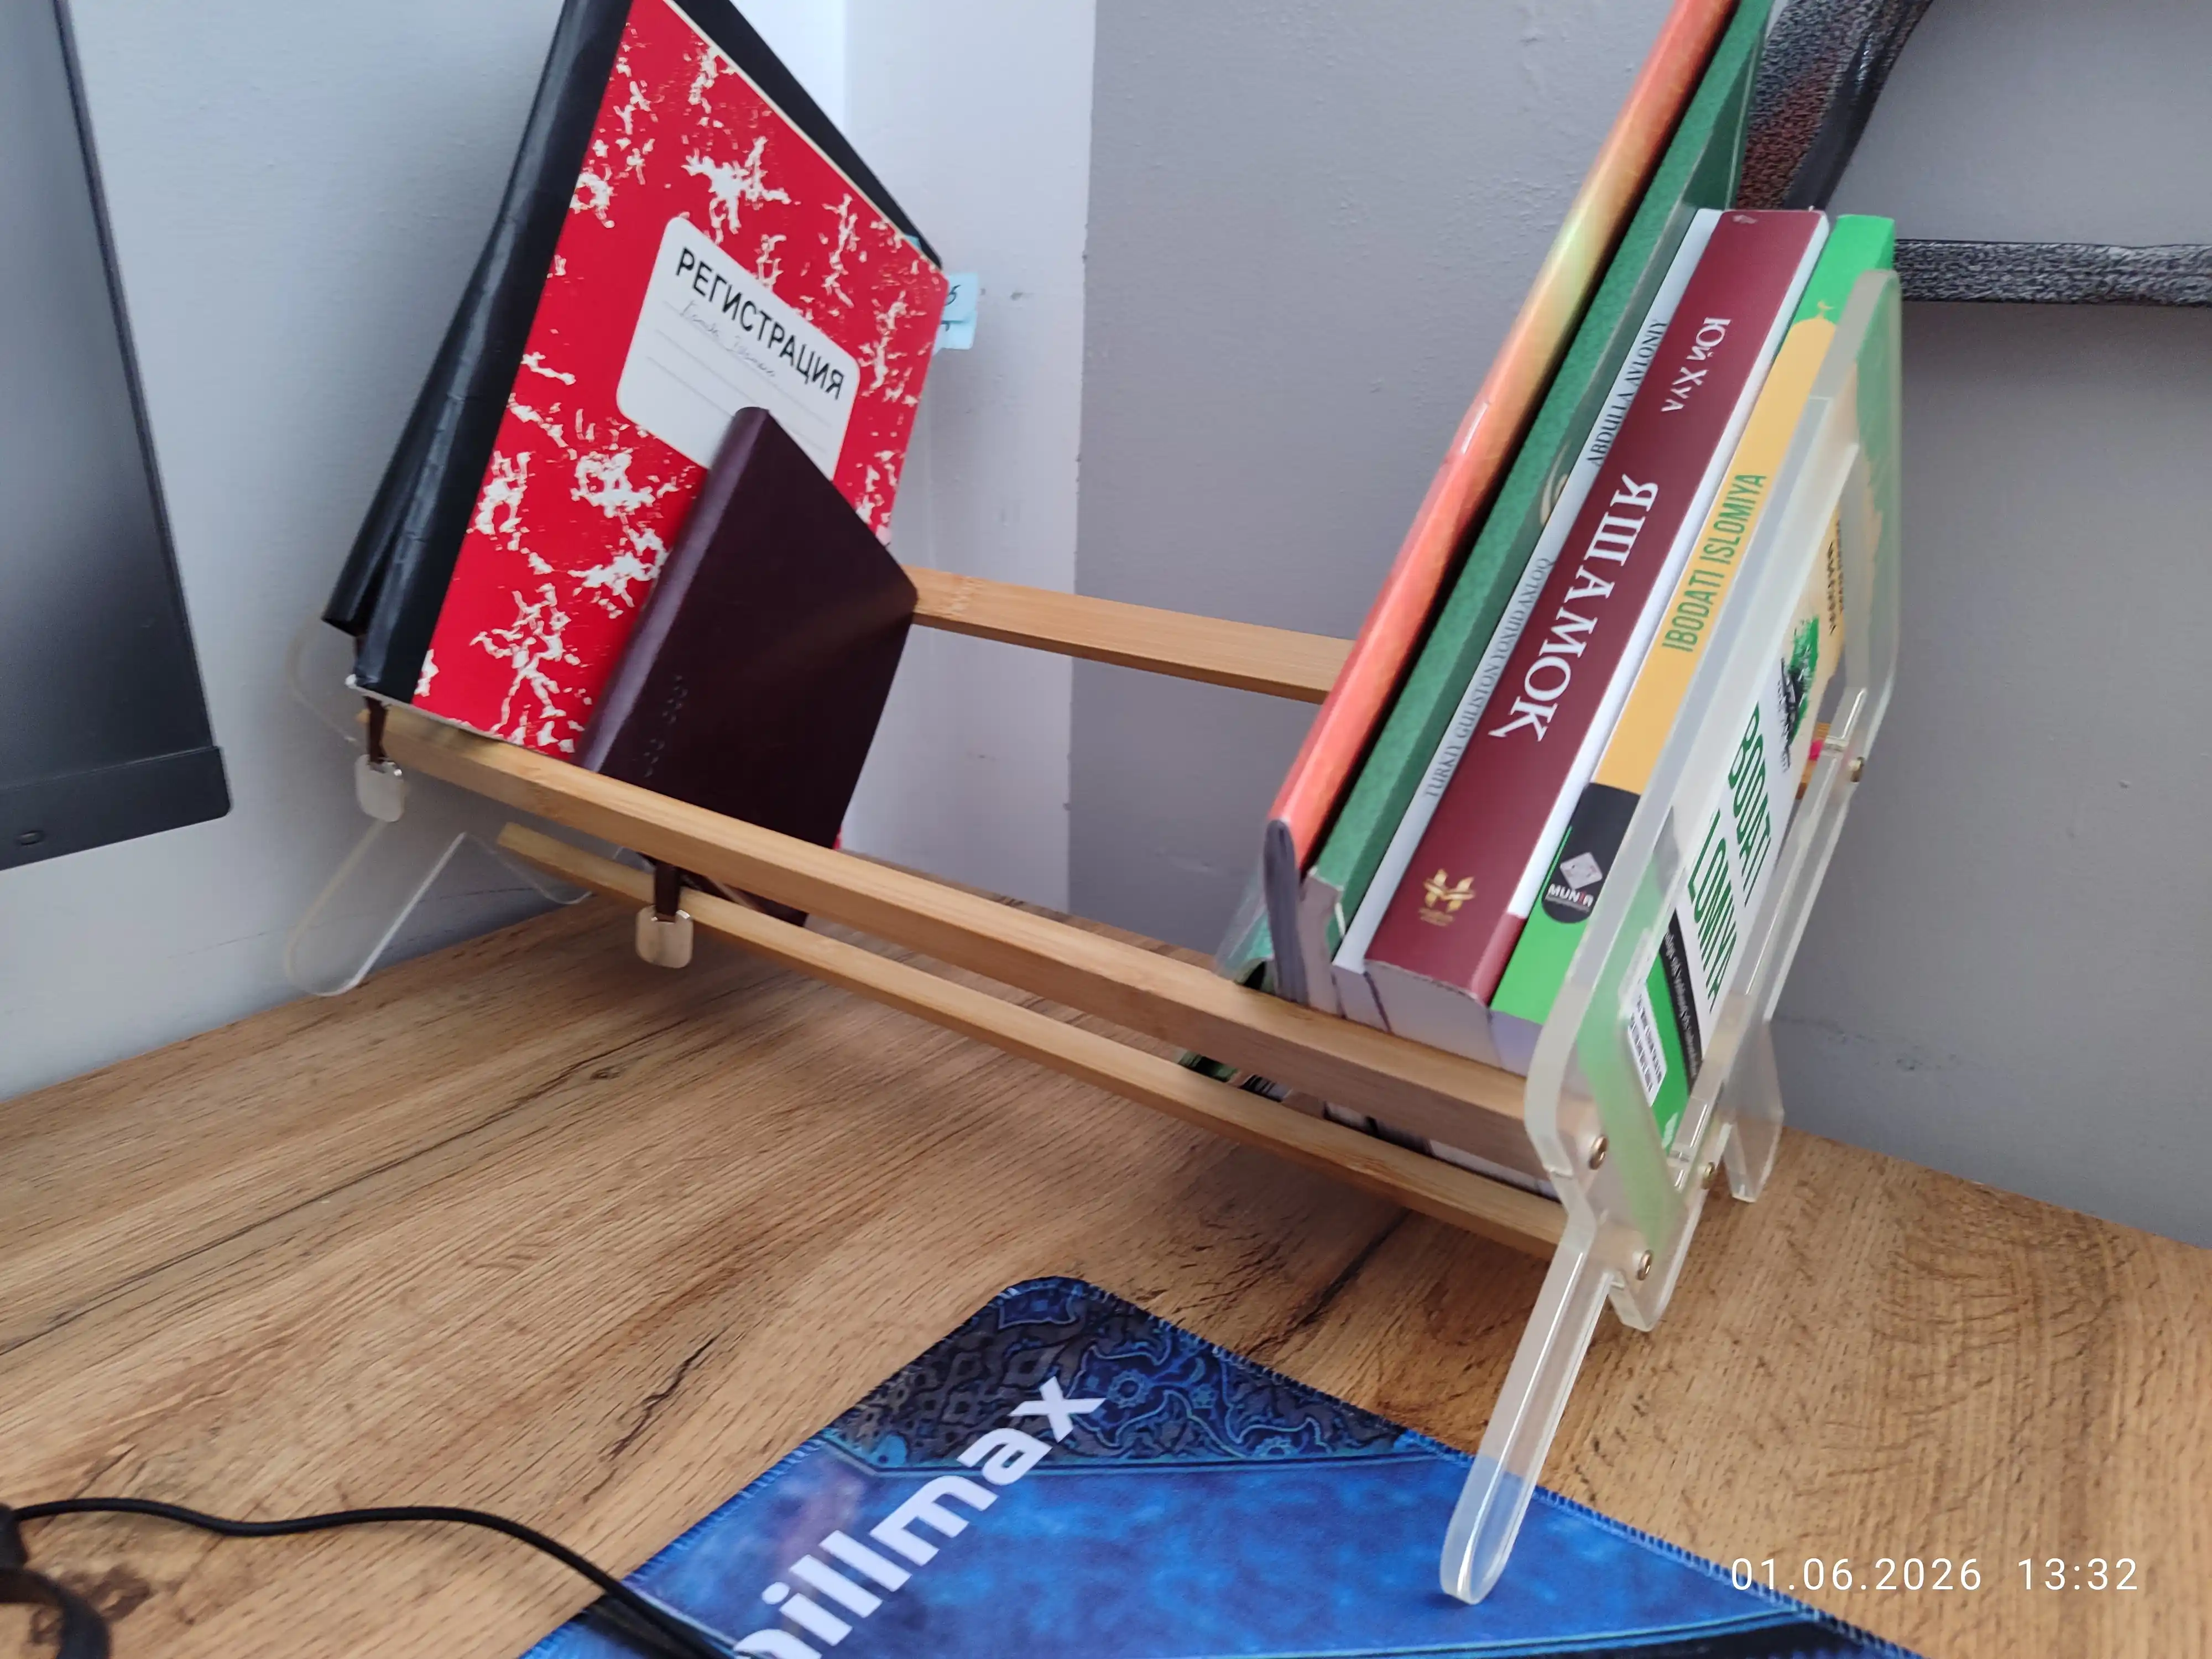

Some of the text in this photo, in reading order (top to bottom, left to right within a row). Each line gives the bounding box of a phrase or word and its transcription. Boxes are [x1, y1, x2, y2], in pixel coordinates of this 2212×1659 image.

[676, 248, 845, 400] РЕГИСТРАЦИЯ
[1586, 317, 1670, 466] ABDULLA AVLONIY
[1489, 474, 1659, 742] ЯШАМОҚ
[1662, 473, 1767, 653] IBODATI ISLOMIYA
[1424, 741, 1462, 797] TURKIY
[1454, 665, 1501, 737] GULISTON
[1490, 608, 1526, 659] YOXUD
[1728, 701, 1770, 907] BODATI
